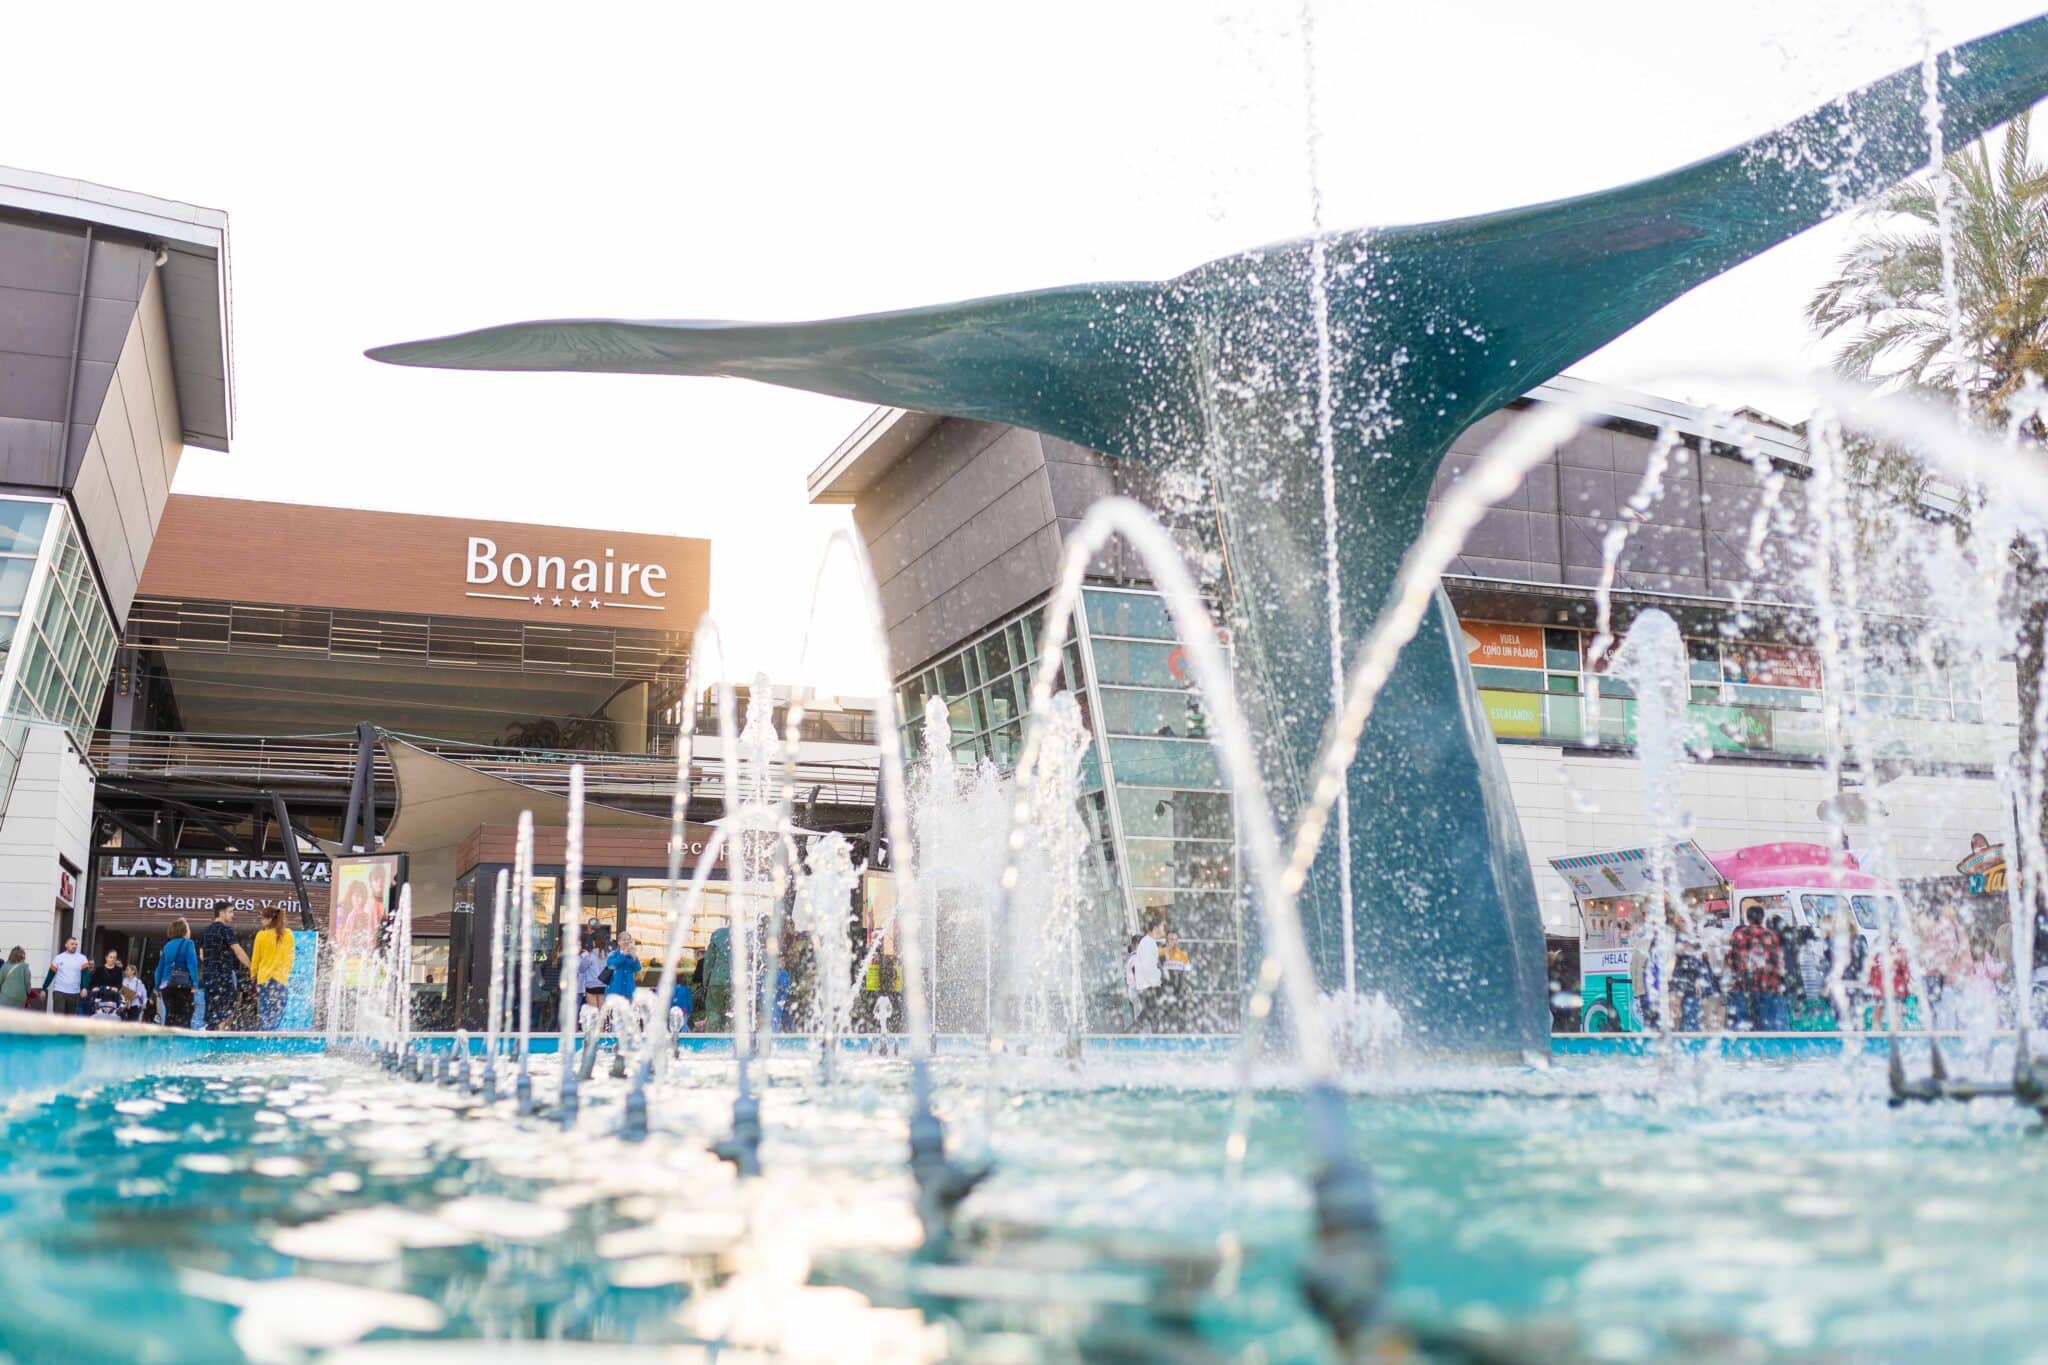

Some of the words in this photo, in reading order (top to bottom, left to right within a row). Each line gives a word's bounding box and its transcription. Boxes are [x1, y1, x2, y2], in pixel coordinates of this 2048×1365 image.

[466, 536, 668, 598] Bonaire
[1482, 644, 1501, 656] COMO
[1503, 645, 1513, 656] UN
[112, 856, 173, 876] LAS
